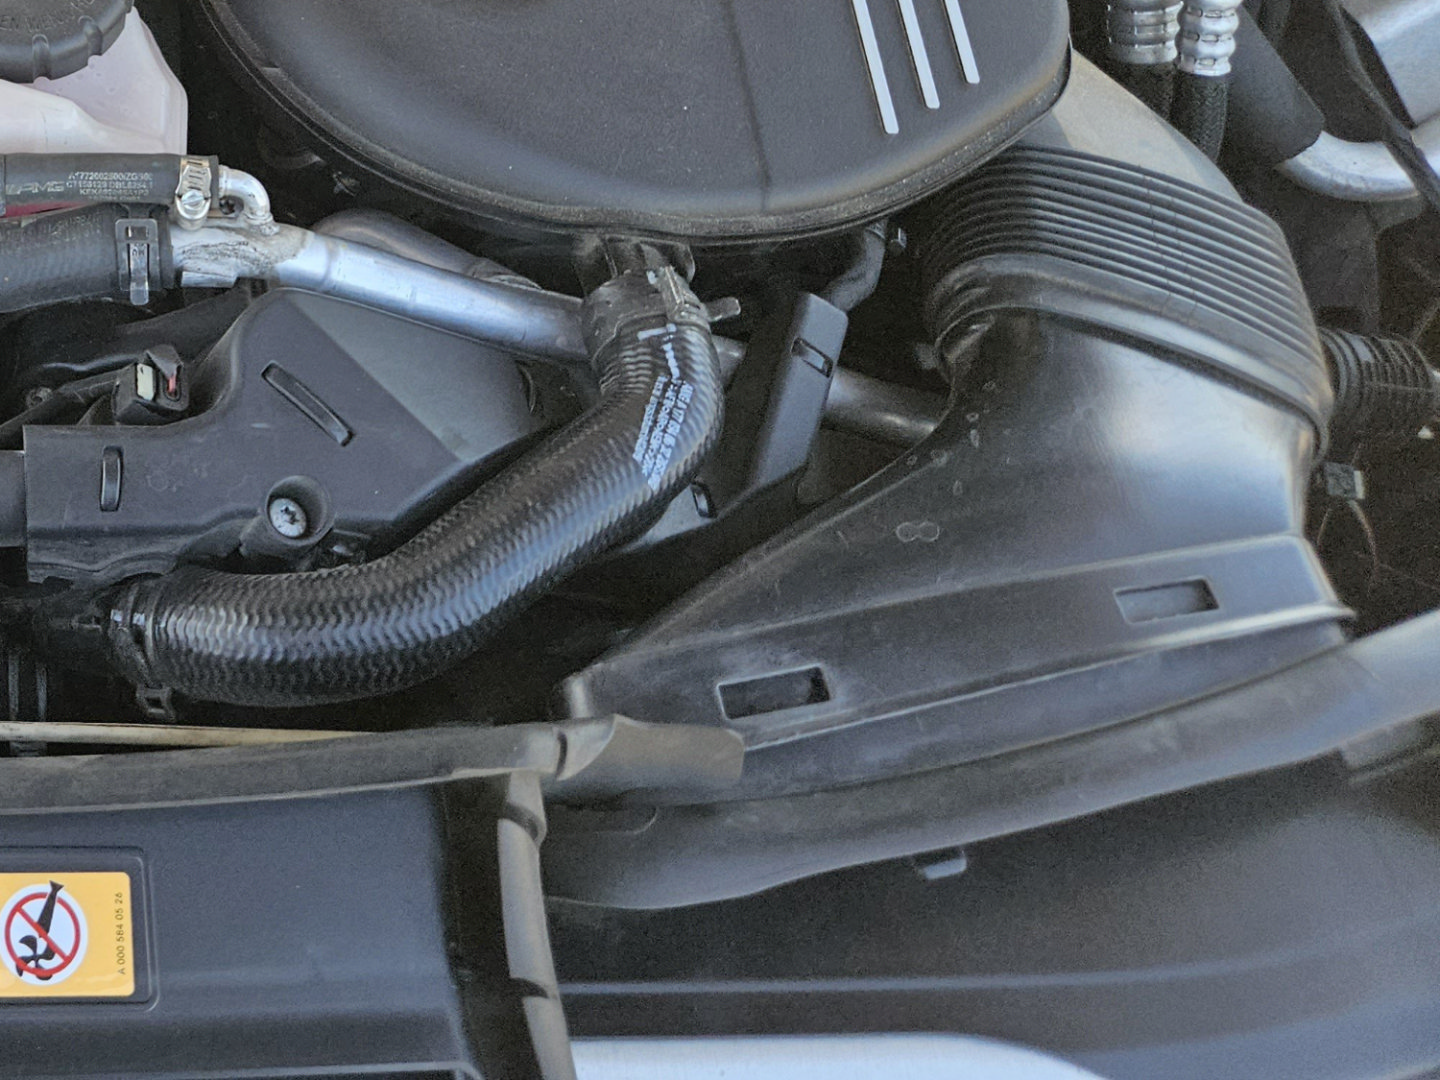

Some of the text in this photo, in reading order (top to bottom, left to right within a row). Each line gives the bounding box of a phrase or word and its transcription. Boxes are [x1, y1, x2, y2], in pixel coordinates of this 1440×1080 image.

[114, 907, 124, 921] 05
[115, 923, 125, 942] 584
[116, 945, 126, 965] 000
[117, 967, 126, 975] A
